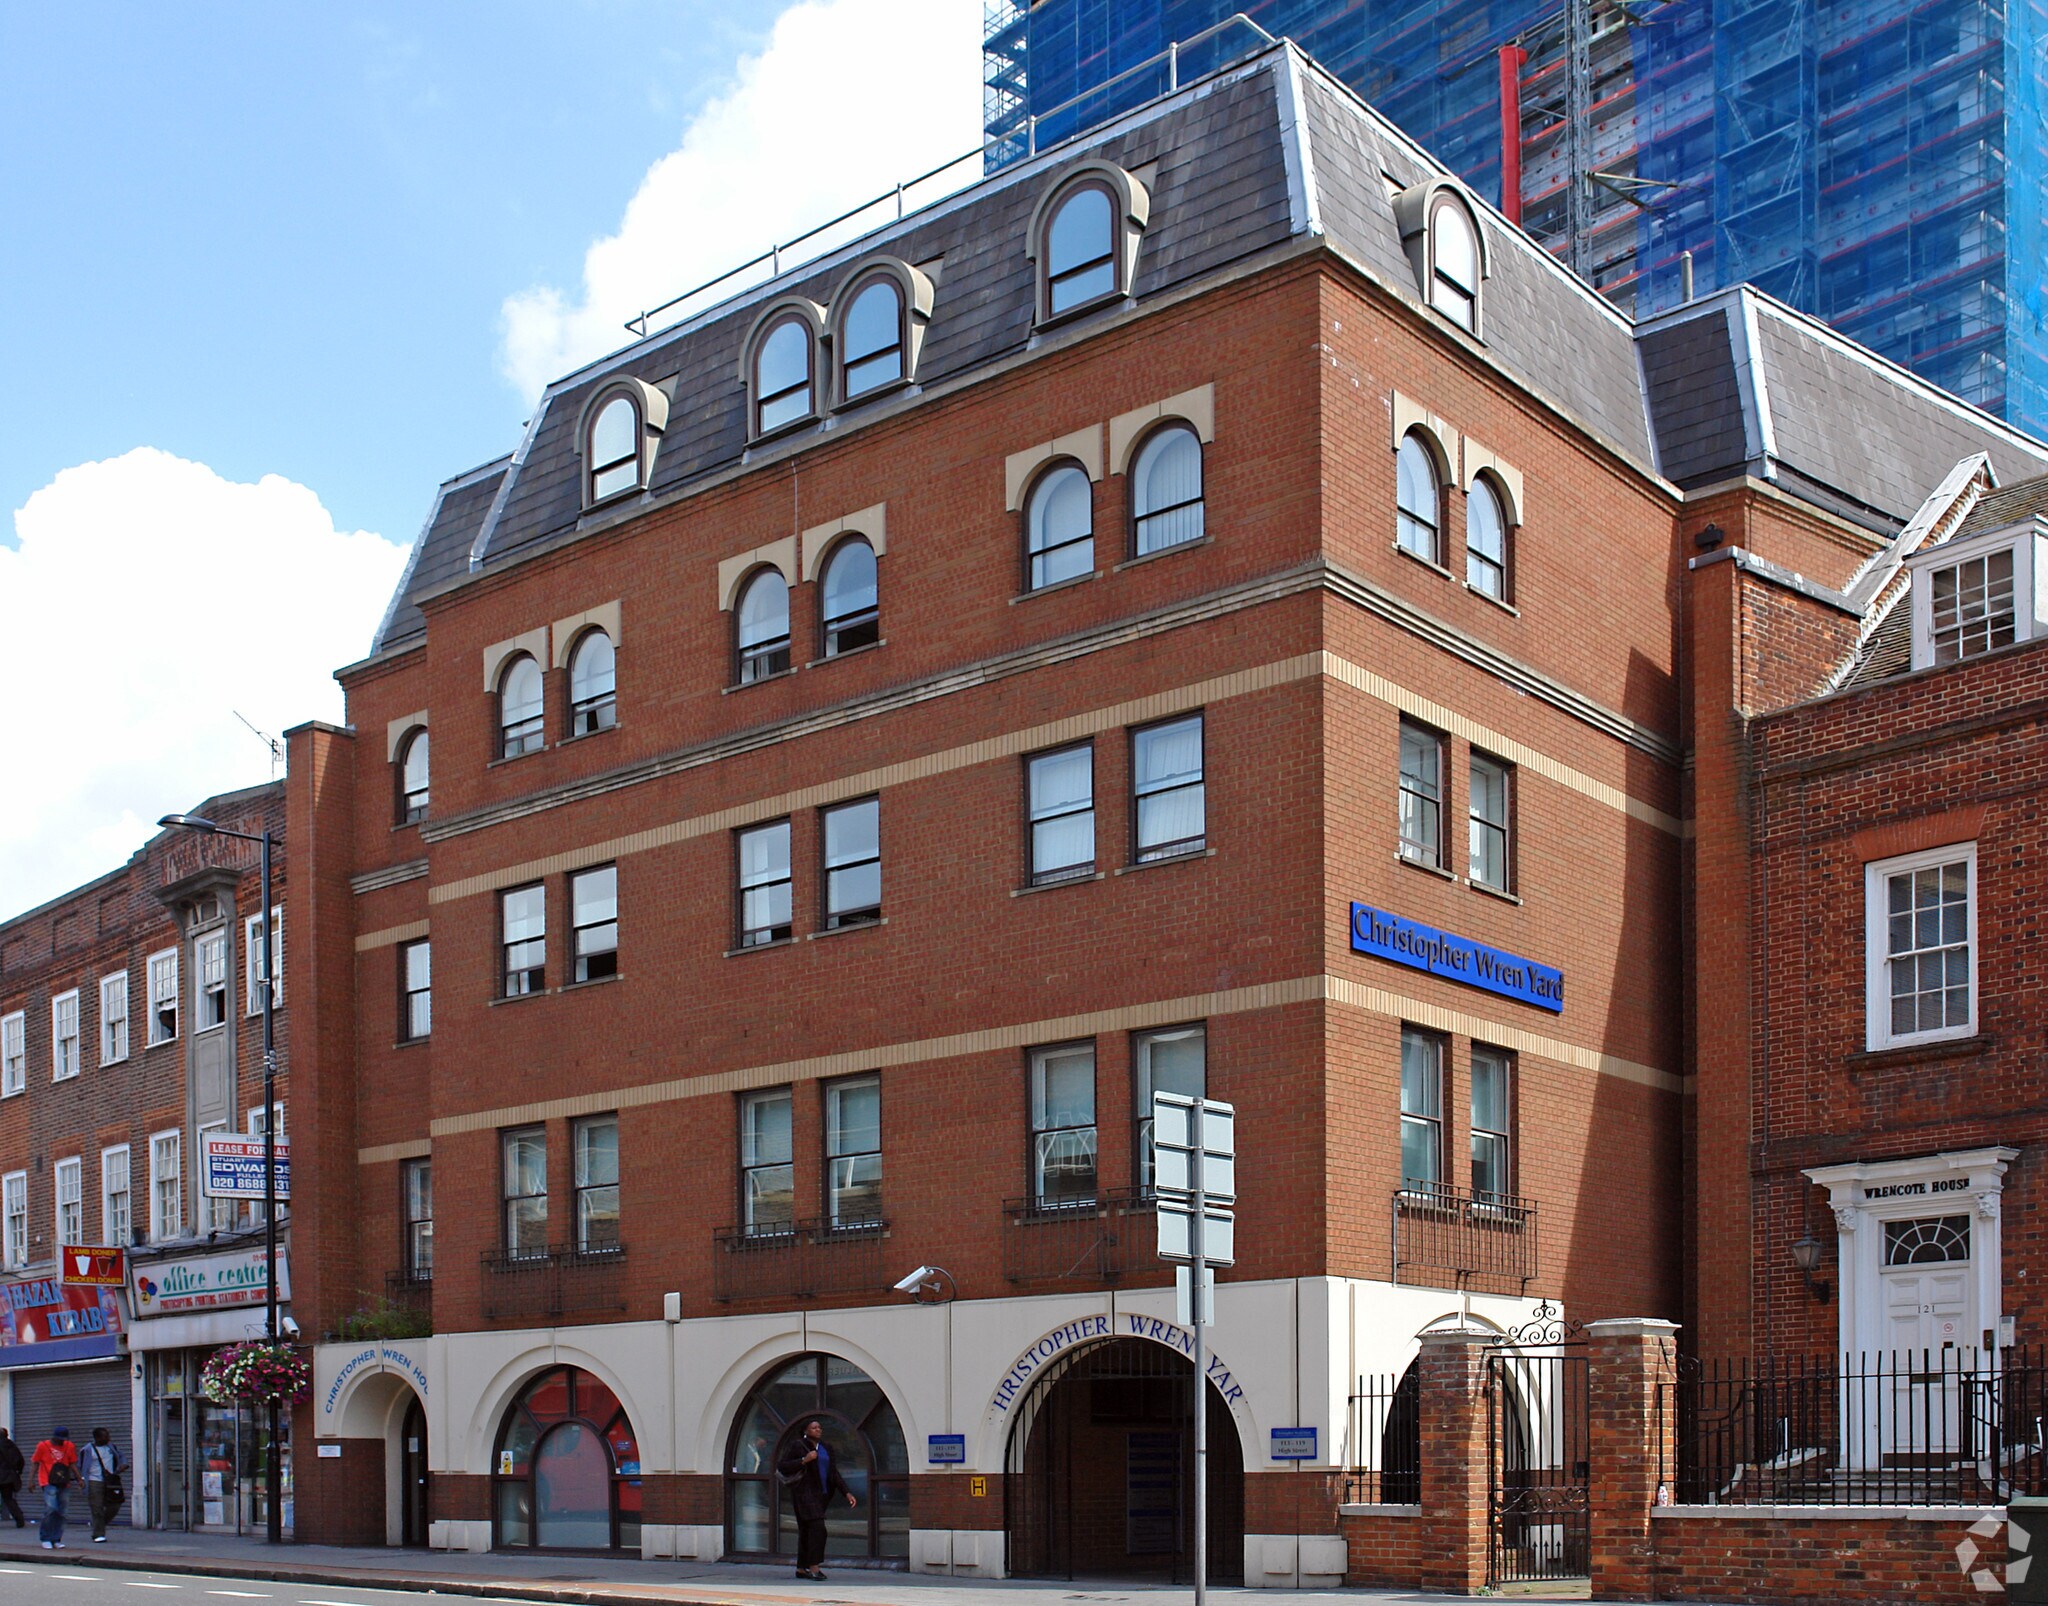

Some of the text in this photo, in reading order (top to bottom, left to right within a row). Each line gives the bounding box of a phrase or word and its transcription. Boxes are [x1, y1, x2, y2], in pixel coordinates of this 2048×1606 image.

[1354, 908, 1564, 1002] Christopher Wren Yard
[212, 1143, 243, 1154] LEASE
[246, 1145, 267, 1156] FOR
[212, 1178, 233, 1188] 020
[1864, 1178, 1970, 1199] WRENCOTE HOUSE
[163, 1266, 206, 1292] office
[1917, 1304, 1935, 1313] 121
[47, 1306, 103, 1337] KEBAB
[1129, 1315, 1196, 1354] WREN
[325, 1349, 376, 1414] CHRISTOPHER
[382, 1348, 412, 1369] WREN
[972, 1479, 984, 1495] H
